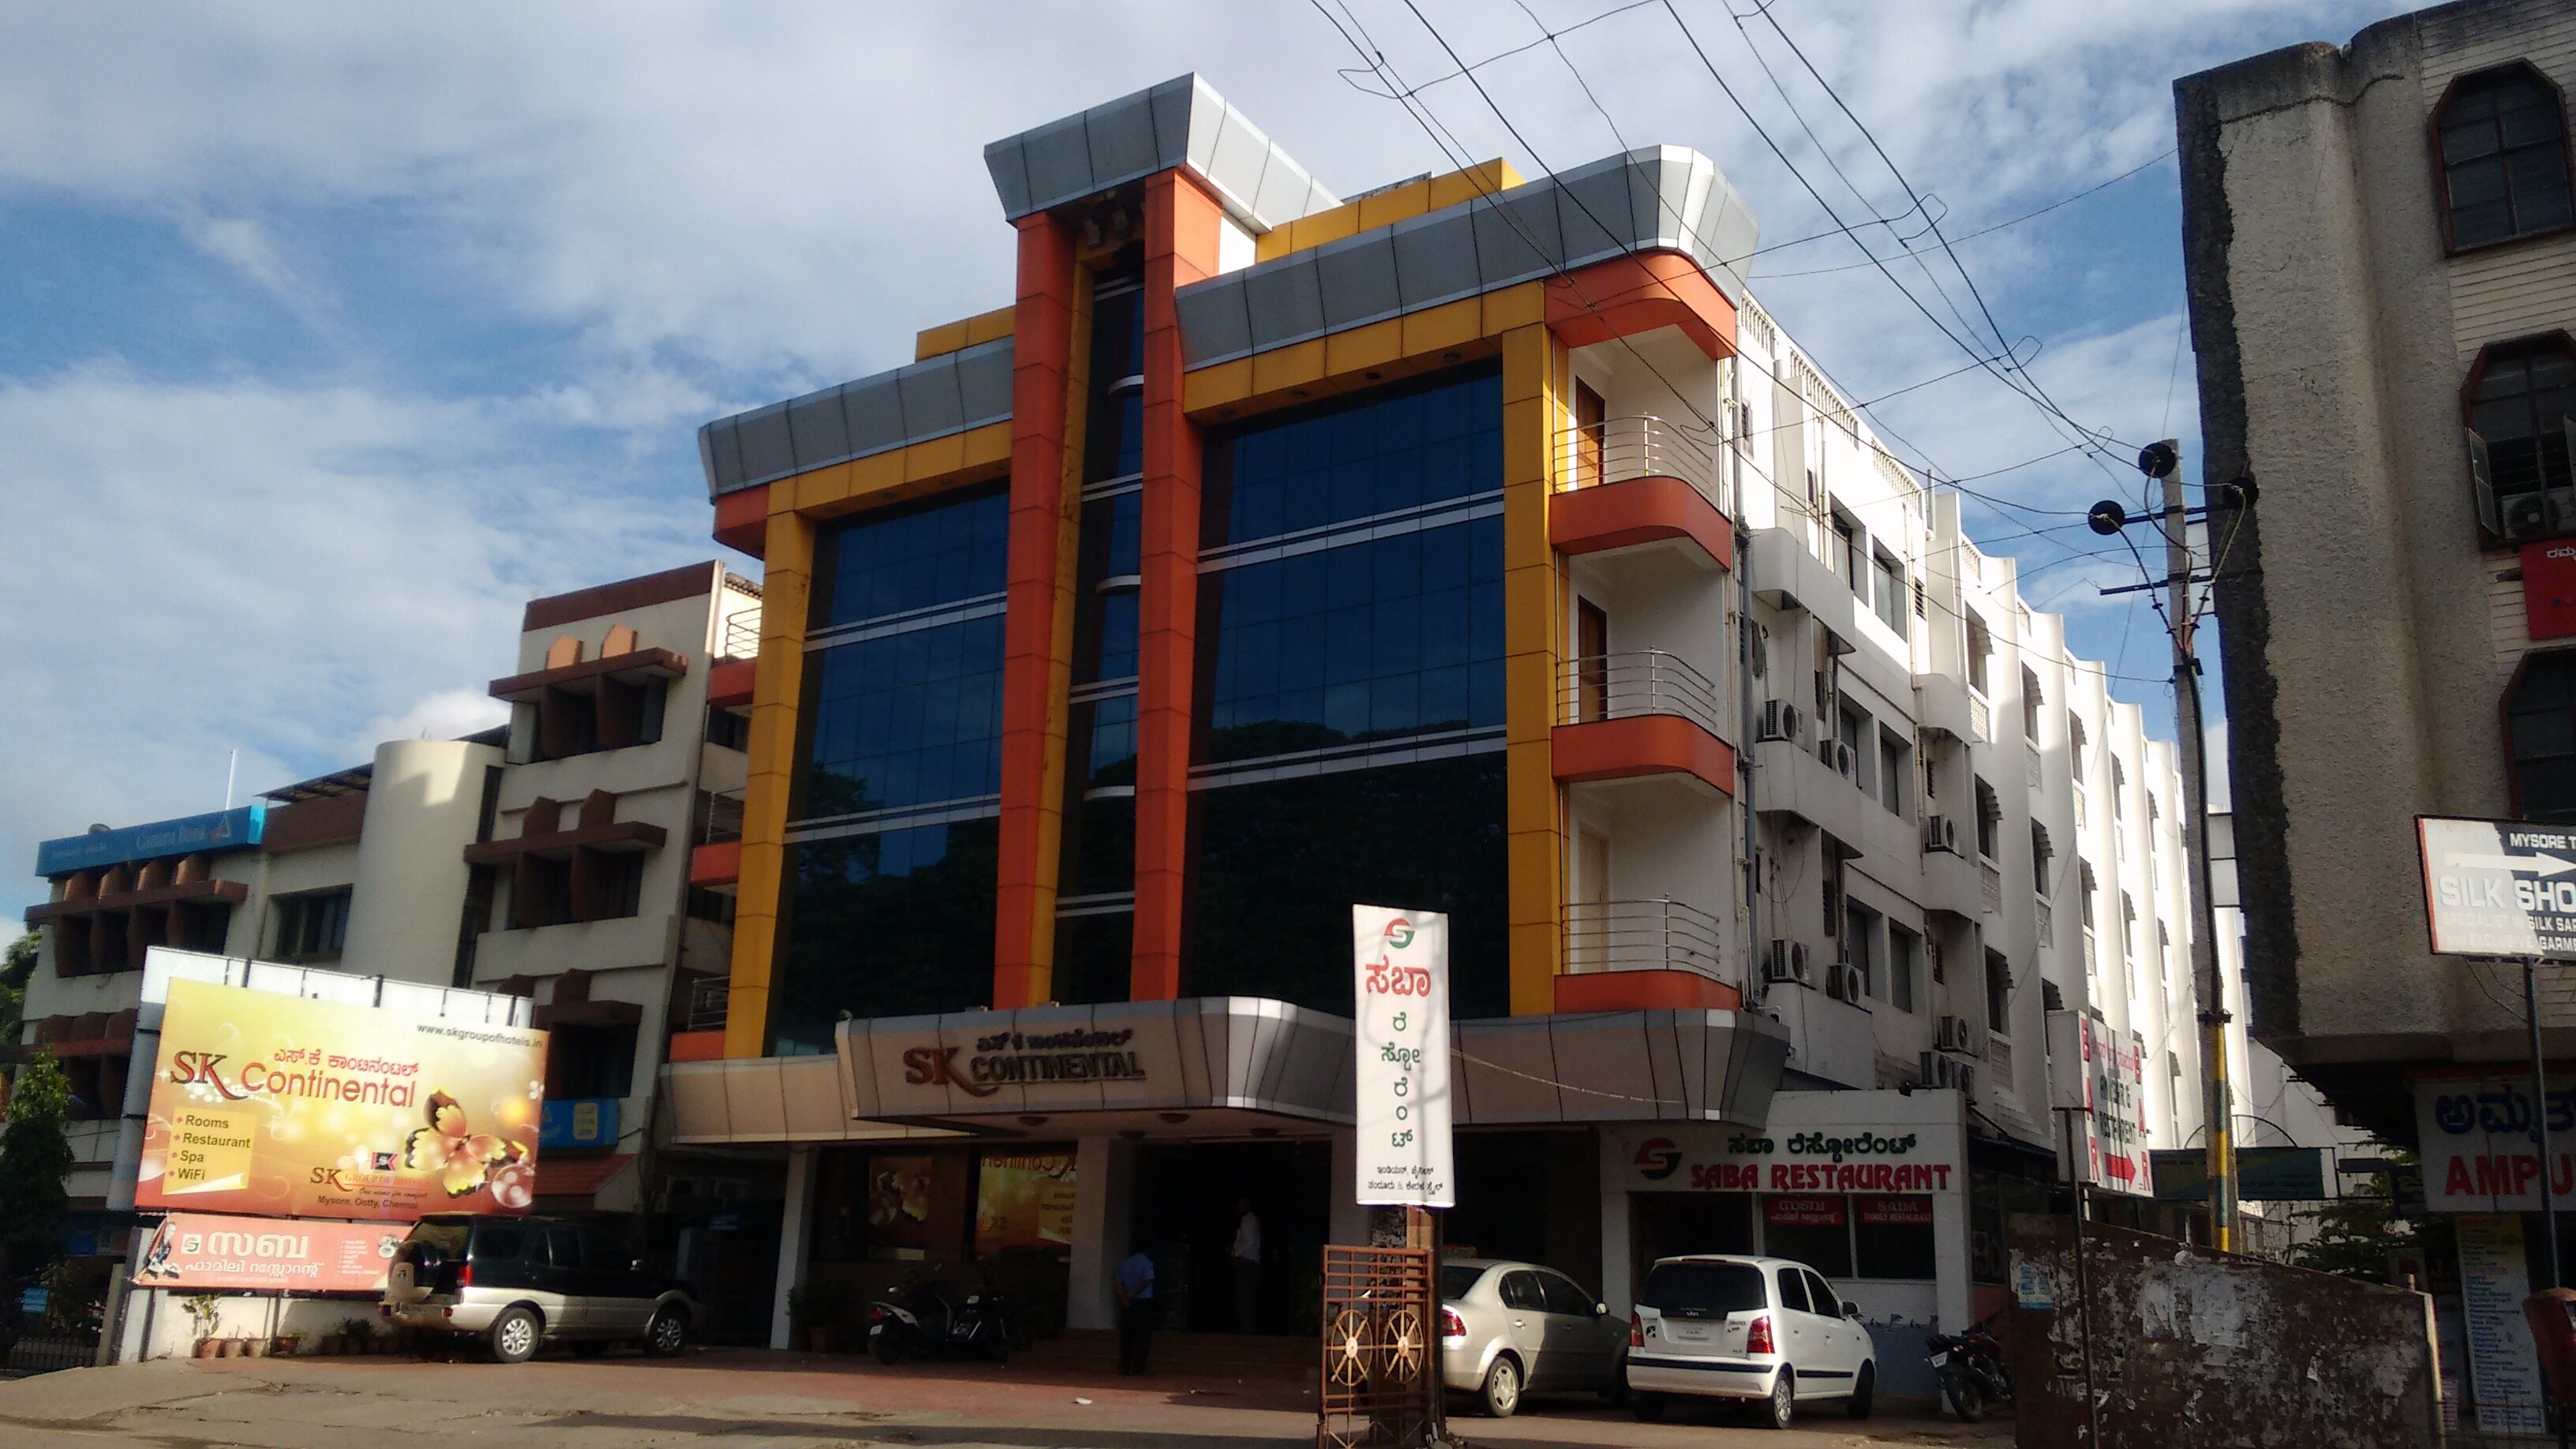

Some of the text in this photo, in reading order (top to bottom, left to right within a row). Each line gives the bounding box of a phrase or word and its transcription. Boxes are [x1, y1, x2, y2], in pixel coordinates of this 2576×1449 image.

[2510, 833, 2566, 848] MYSORE
[2439, 874, 2505, 908] SILK
[2528, 916, 2555, 930] SILK
[1365, 954, 1432, 997] ಸಬಾ
[417, 1024, 542, 1048] www.skgroupofhotels.in
[170, 1050, 416, 1107] SK Continental
[903, 1046, 1145, 1098] SK CONTINENTAL
[185, 1114, 229, 1129] Rooms
[182, 1133, 251, 1148] Restaurant
[1728, 1133, 1774, 1155] ಸಬಾ
[180, 1150, 204, 1164] Spa
[178, 1167, 205, 1180] WiFi
[310, 1167, 353, 1192] SK
[1691, 1163, 1951, 1191] SABA RESTAURANT
[317, 1195, 352, 1206] Mysore,
[207, 1231, 309, 1259] സബ
